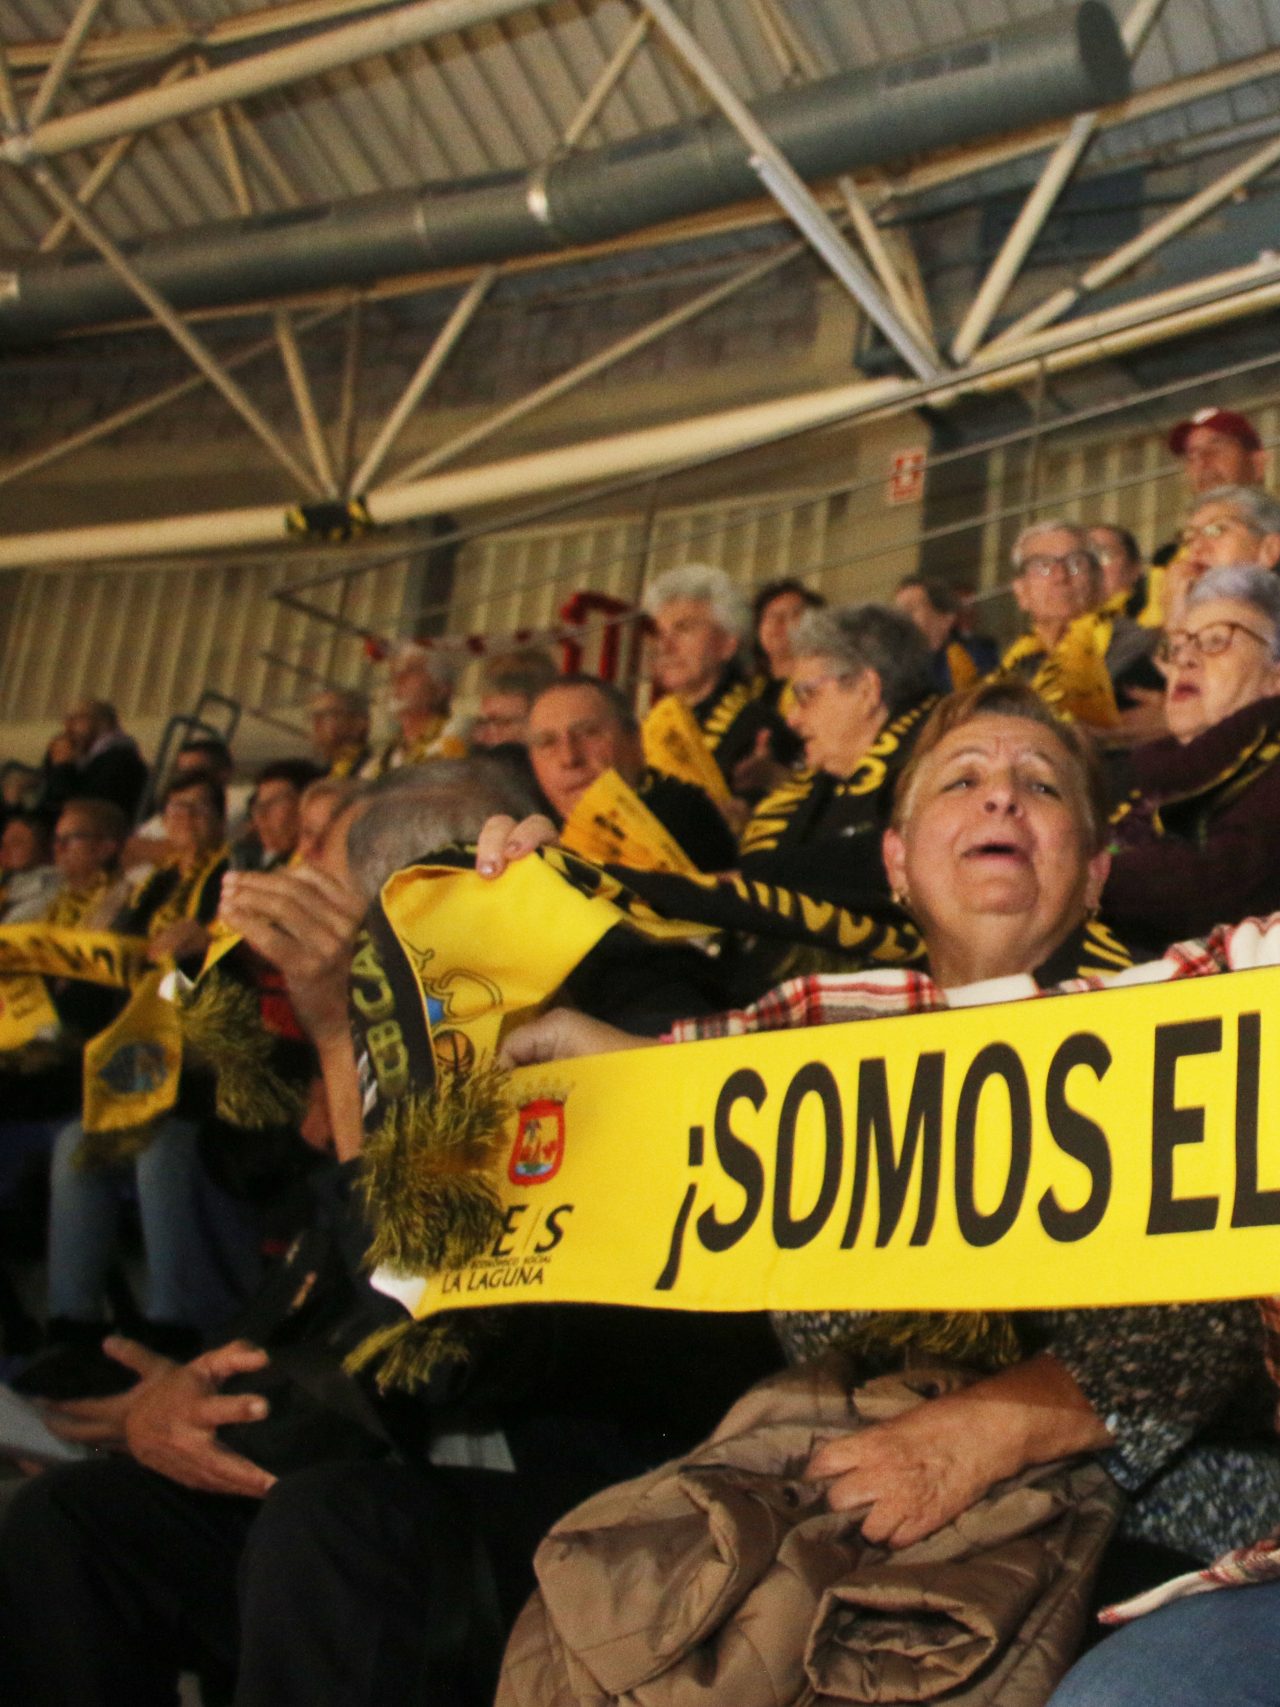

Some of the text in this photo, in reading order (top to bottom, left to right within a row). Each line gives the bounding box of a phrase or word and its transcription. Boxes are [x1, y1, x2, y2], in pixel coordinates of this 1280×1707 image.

[654, 1032, 1112, 1292] ¡SOMOS
[442, 1267, 543, 1294] LA LAGUNA
